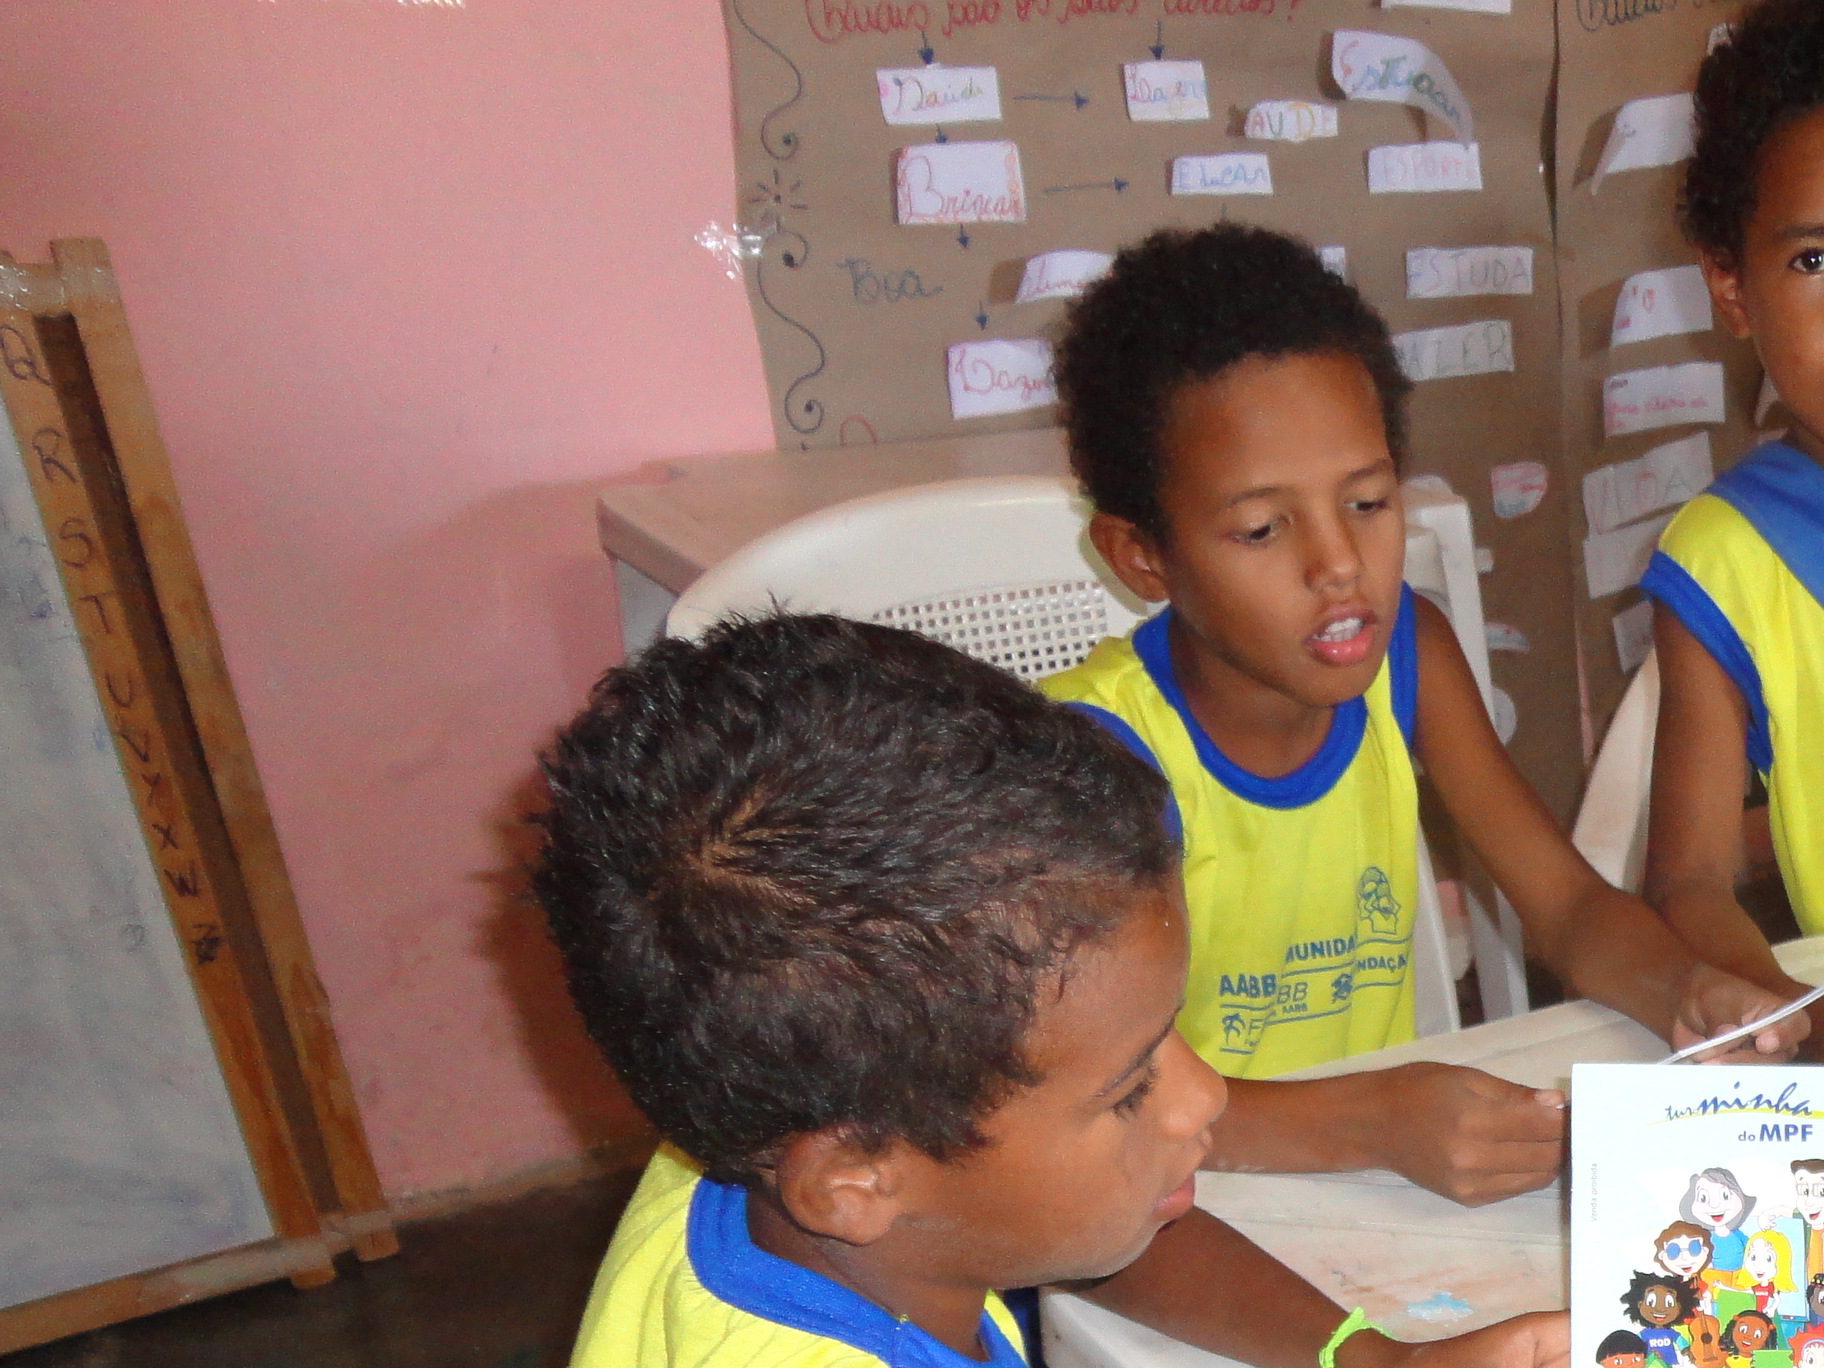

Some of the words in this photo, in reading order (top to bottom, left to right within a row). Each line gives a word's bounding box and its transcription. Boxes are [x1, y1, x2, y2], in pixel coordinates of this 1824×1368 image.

[33, 427, 77, 482] R
[58, 519, 93, 568] S
[79, 594, 115, 636] T
[1738, 1130, 1756, 1142] do
[1759, 1124, 1813, 1142] MPF
[1649, 1337, 1671, 1347] ROD
